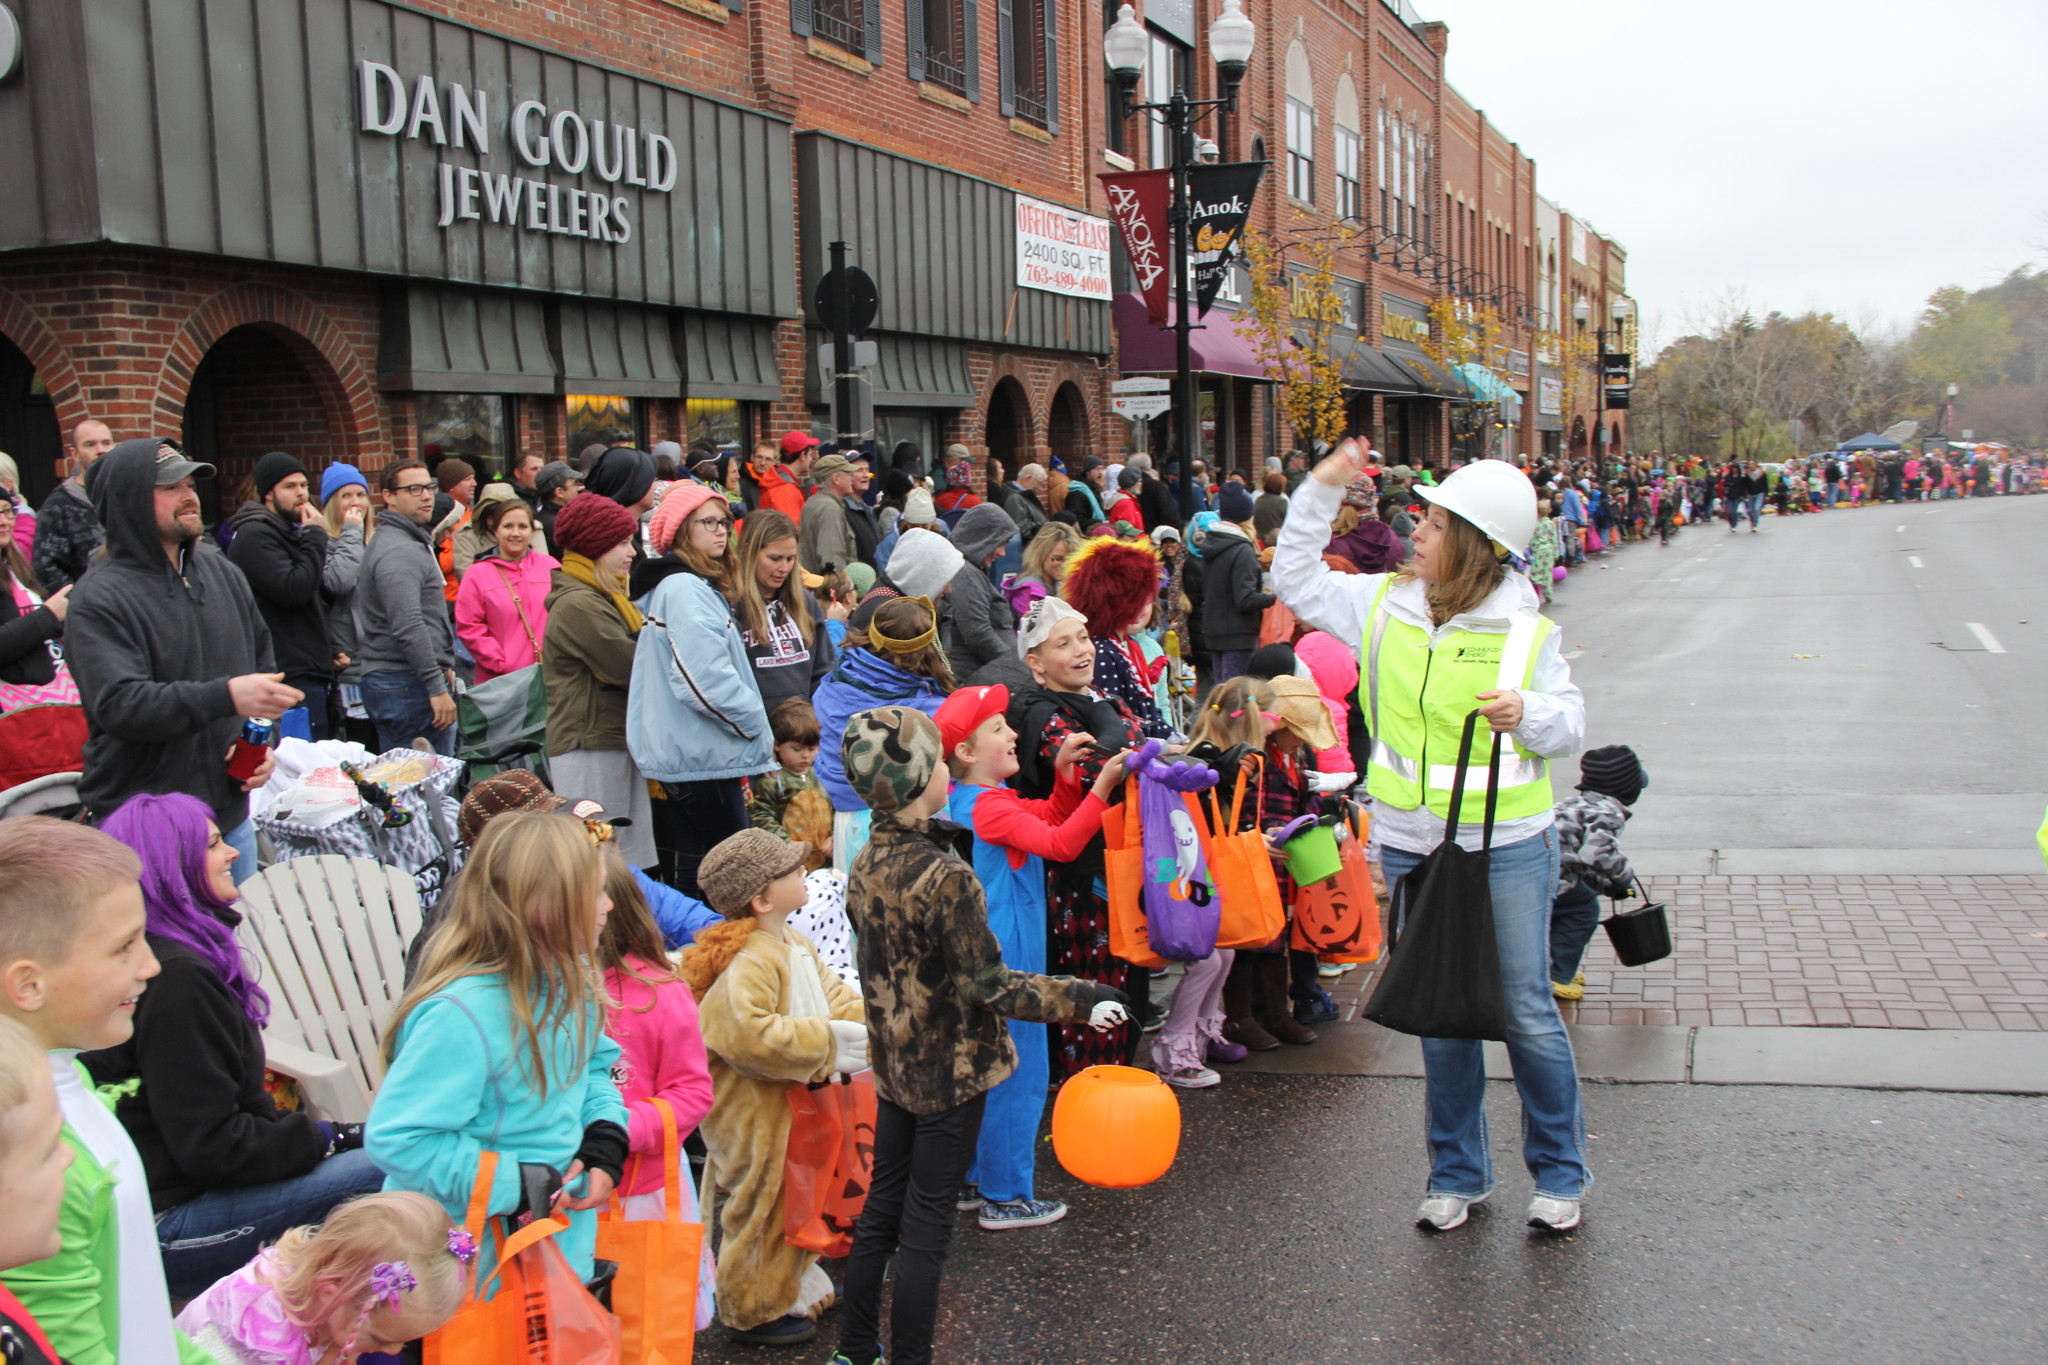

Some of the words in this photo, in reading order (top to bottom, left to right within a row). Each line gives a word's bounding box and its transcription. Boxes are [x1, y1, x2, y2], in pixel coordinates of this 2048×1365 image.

[359, 60, 488, 154] DAN
[511, 101, 678, 193] GOULD
[437, 163, 632, 244] JEWELERS
[1018, 203, 1067, 243] OFFICES
[1076, 220, 1109, 252] LEASE
[1192, 195, 1248, 220] Anok
[1024, 241, 1058, 264] 2400
[1062, 249, 1085, 270] SQ.
[1089, 255, 1107, 274] FT.
[1108, 185, 1165, 292] ANOKA
[1026, 263, 1107, 295] 763-489-4000
